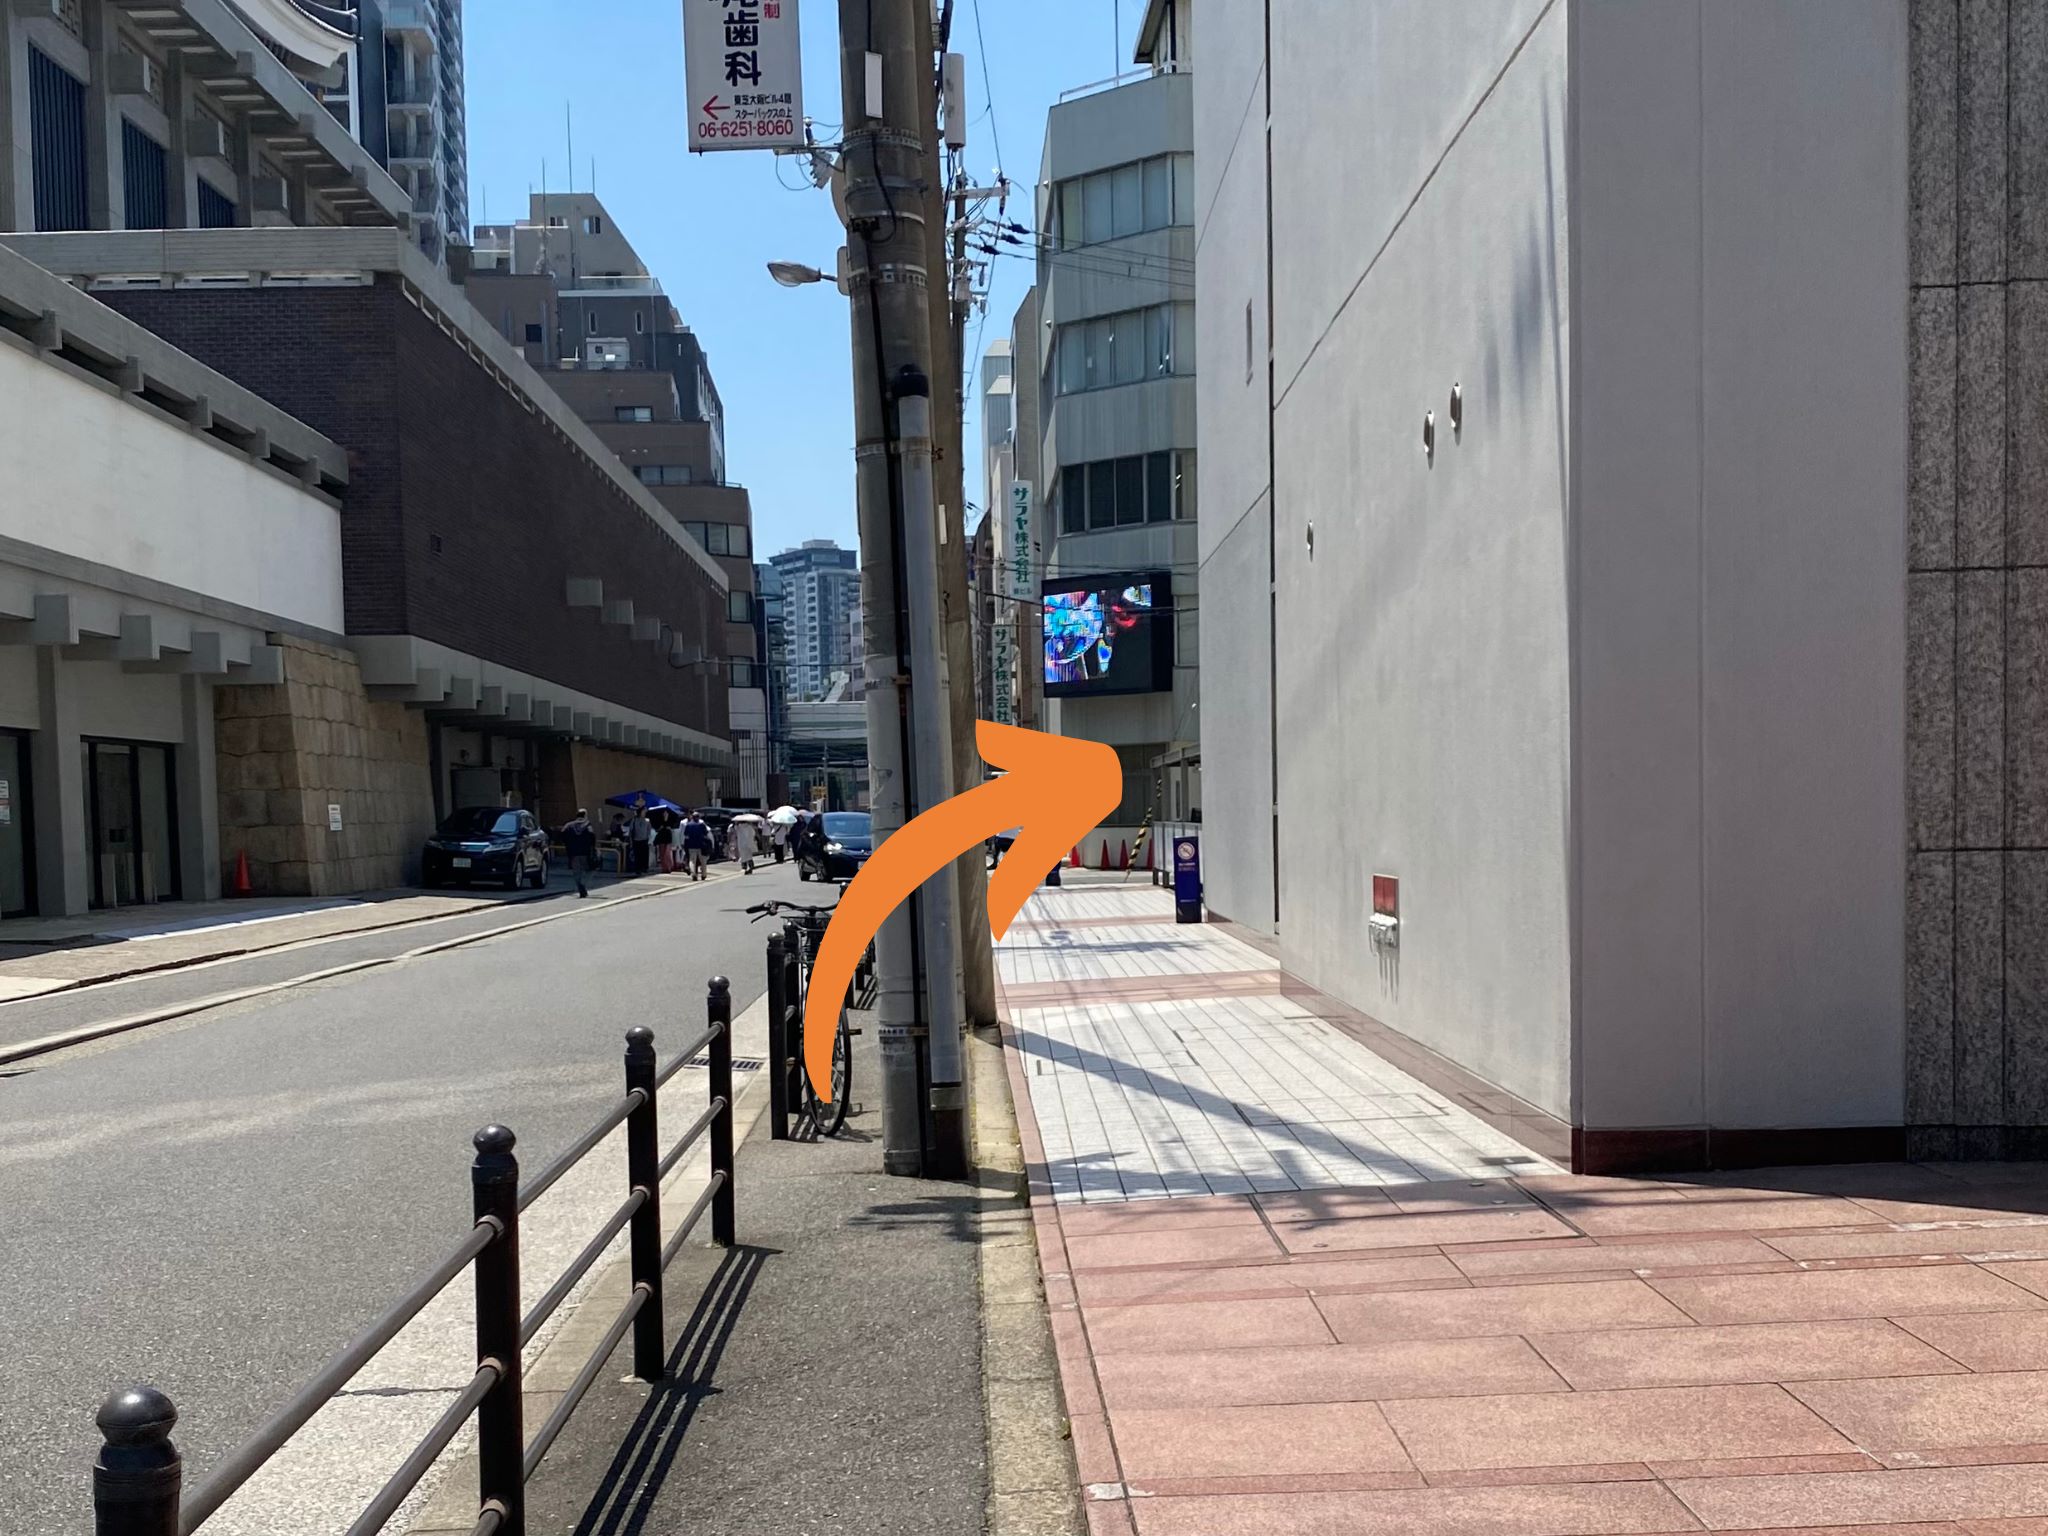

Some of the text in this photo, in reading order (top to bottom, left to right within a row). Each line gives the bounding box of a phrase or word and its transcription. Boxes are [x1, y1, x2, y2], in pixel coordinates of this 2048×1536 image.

[763, 0, 780, 19] 制
[735, 106, 793, 119] スターバックスの上
[698, 119, 794, 138] 06-6251-8060
[1013, 487, 1030, 584] サラヤ株式会社
[994, 628, 1010, 722] サラヤ株式会社
